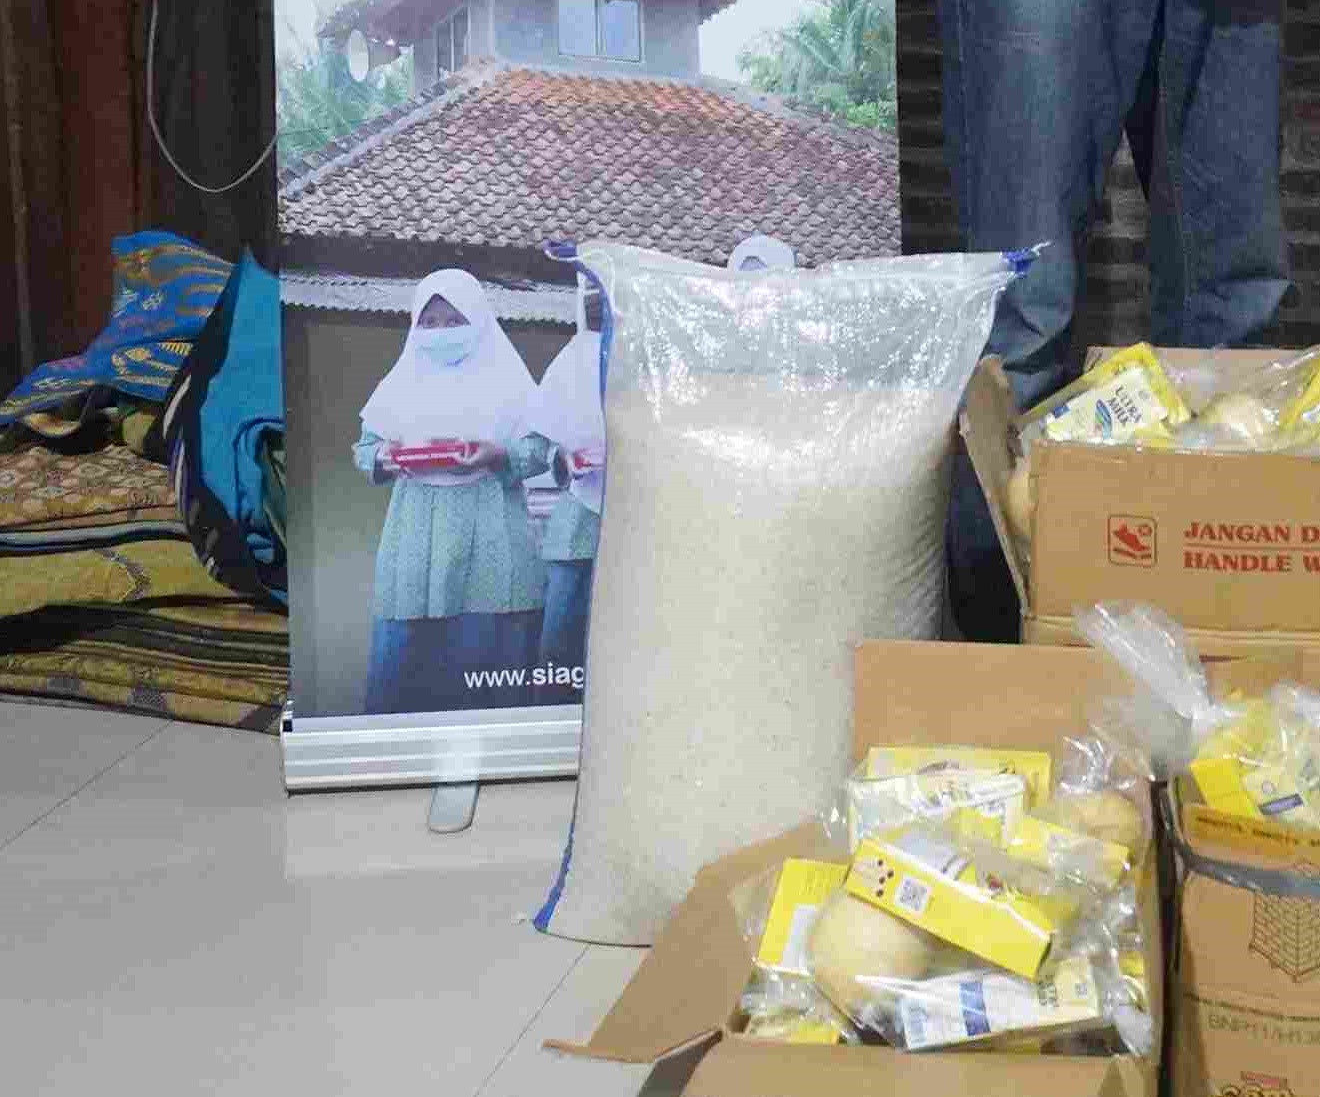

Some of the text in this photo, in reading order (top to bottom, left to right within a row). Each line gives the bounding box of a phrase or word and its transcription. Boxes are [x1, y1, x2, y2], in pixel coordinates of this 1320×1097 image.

[1184, 521, 1290, 545] JANGAN
[1183, 551, 1292, 573] HANDLE
[464, 662, 584, 689] www.siag
